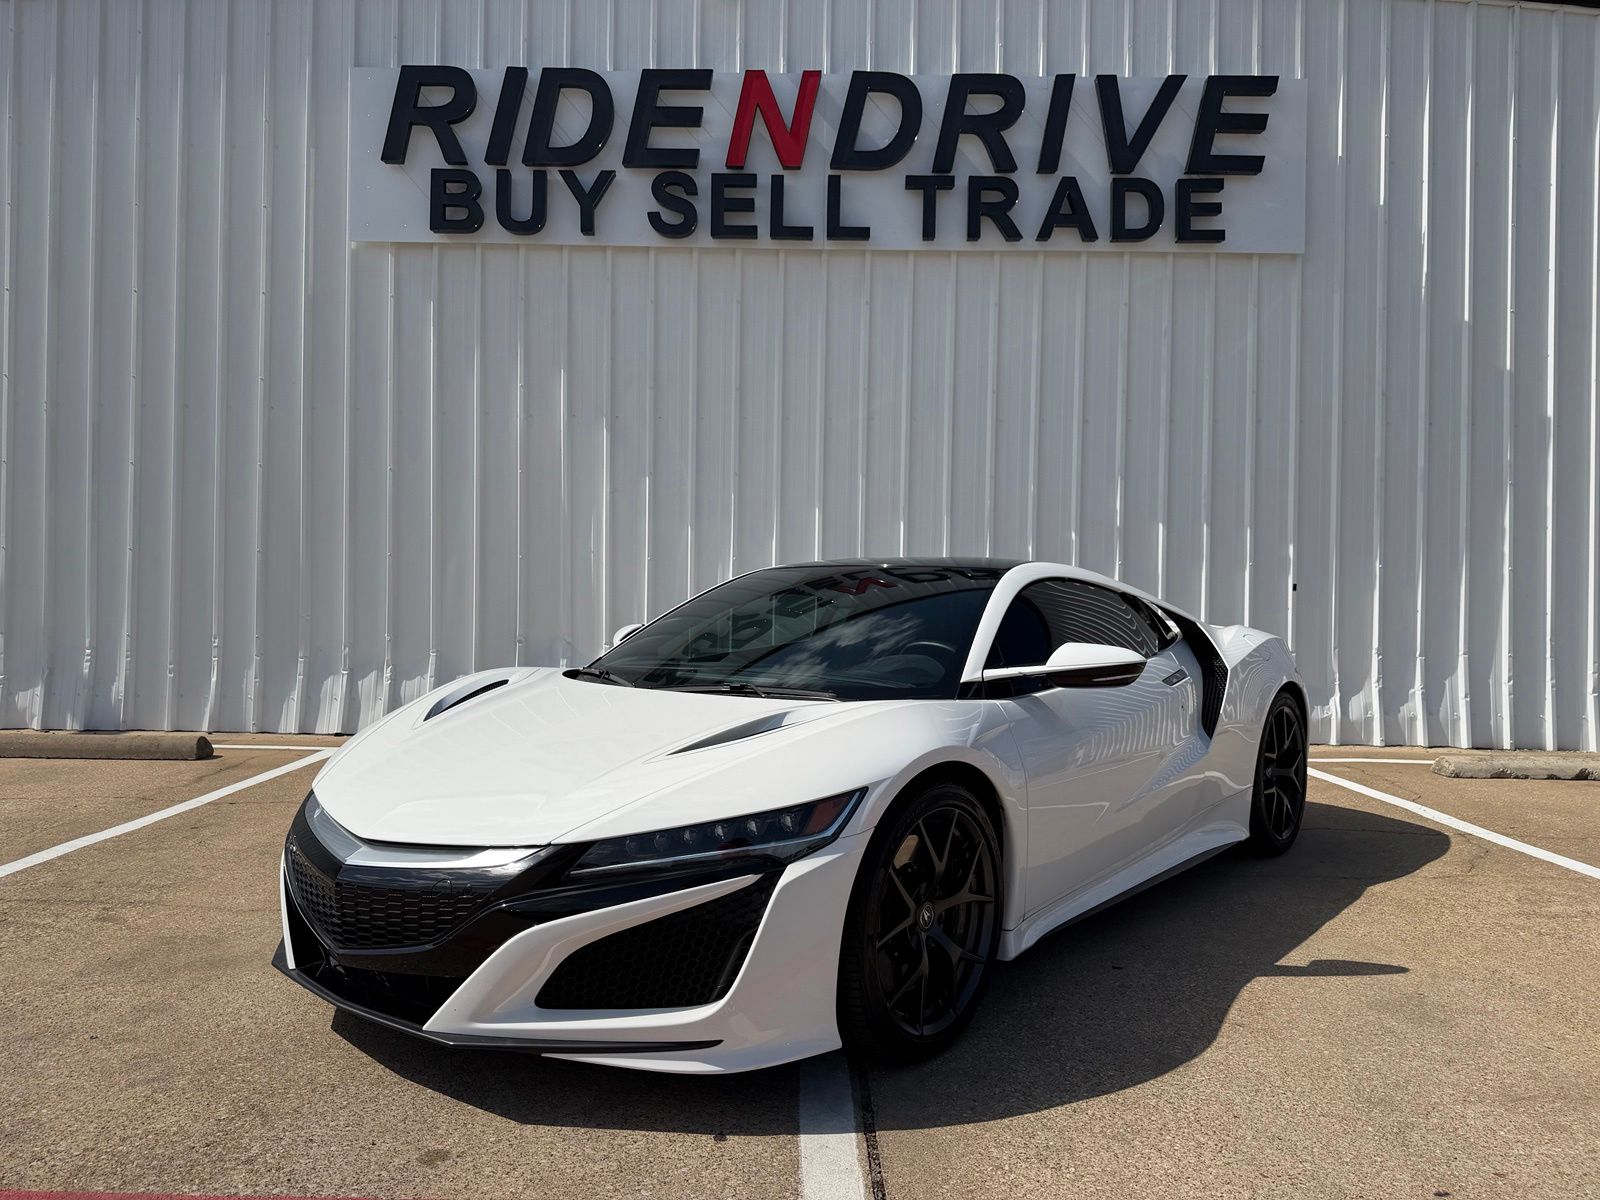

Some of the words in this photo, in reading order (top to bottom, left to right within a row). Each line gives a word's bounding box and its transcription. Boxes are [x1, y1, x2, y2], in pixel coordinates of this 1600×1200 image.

[429, 168, 616, 236] BUY
[647, 170, 870, 241] SELL
[905, 174, 1226, 243] TRADE
